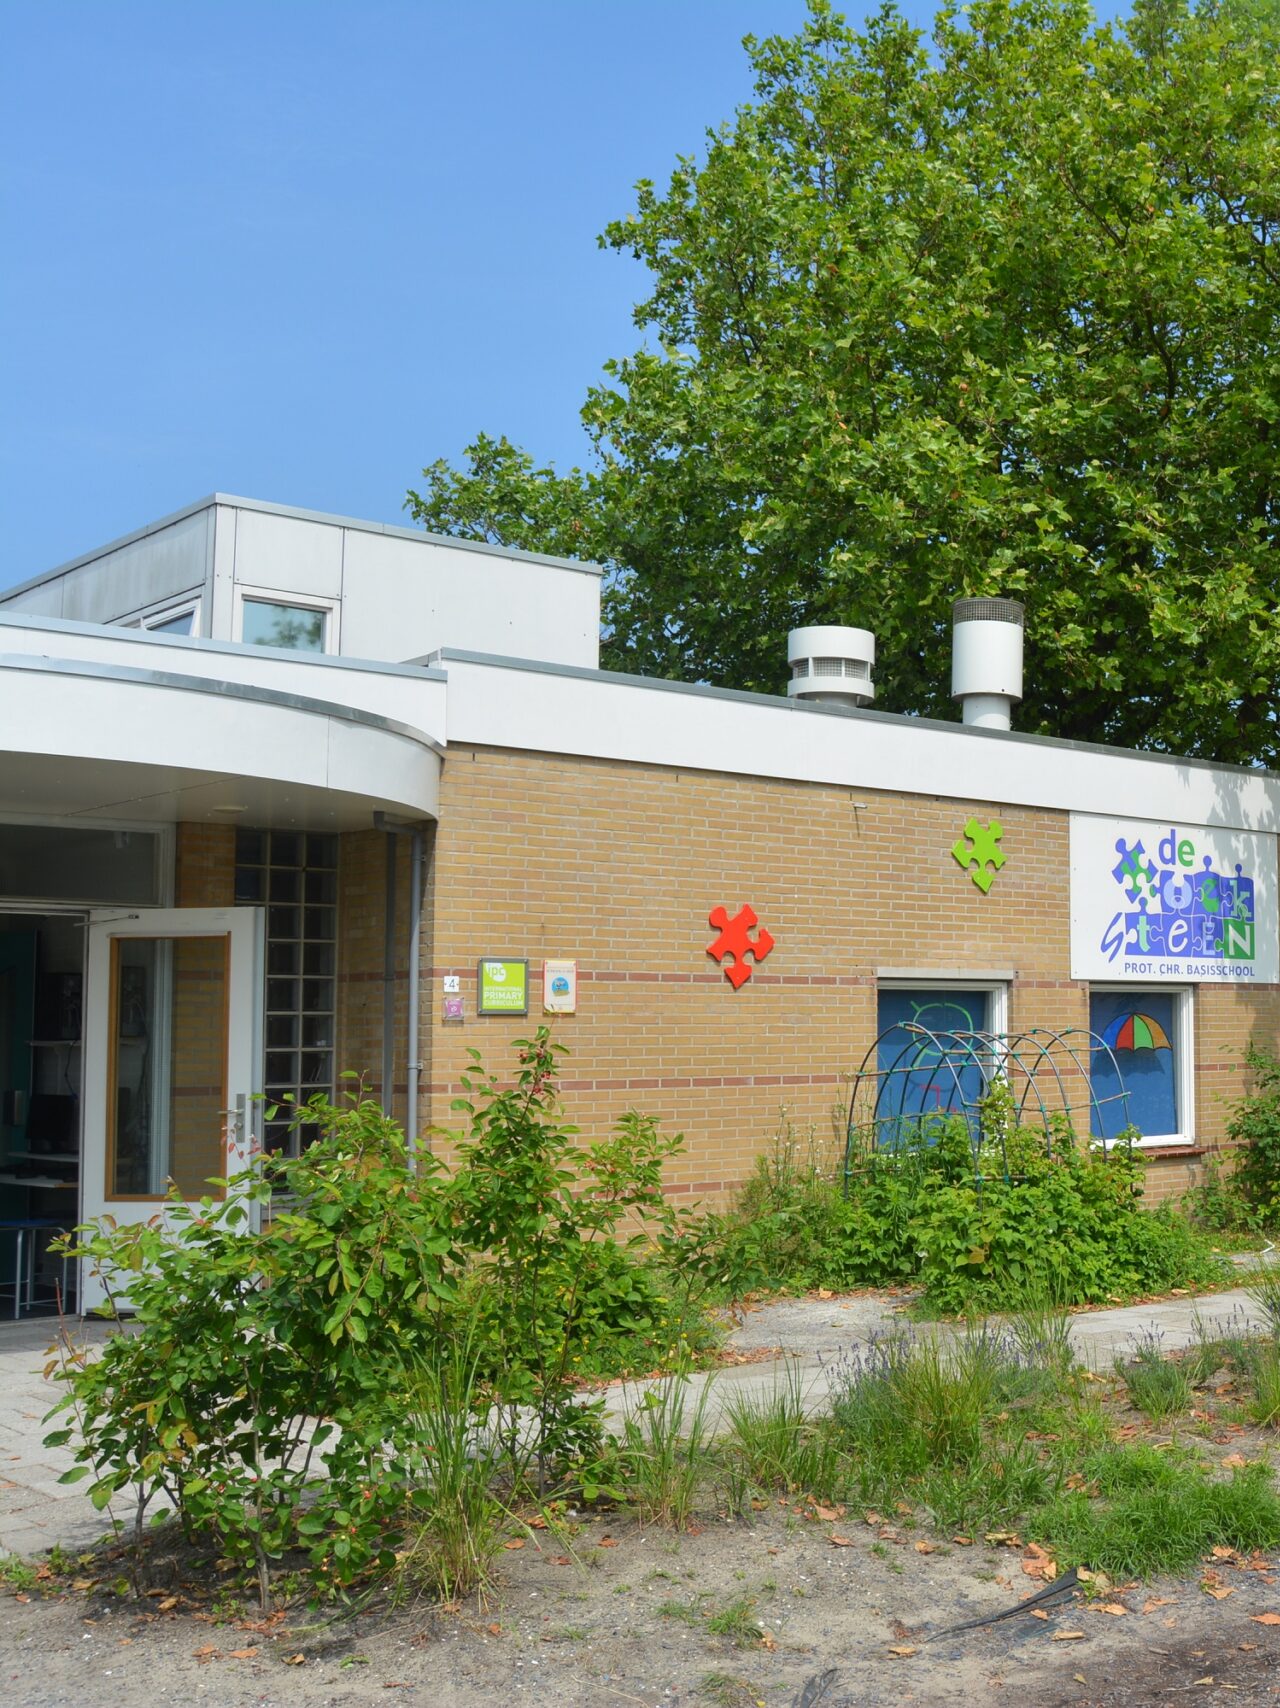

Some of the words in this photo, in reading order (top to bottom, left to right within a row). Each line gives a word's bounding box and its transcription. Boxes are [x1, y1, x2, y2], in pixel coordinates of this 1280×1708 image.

[1158, 829, 1195, 867] de
[1124, 962, 1156, 974] PROT.
[1159, 963, 1184, 975] CHR.
[1187, 964, 1255, 977] BASISSCHOOL
[448, 978, 456, 990] 4
[484, 991, 523, 1000] PRIMARY
[484, 999, 523, 1007] CURRICULUM
